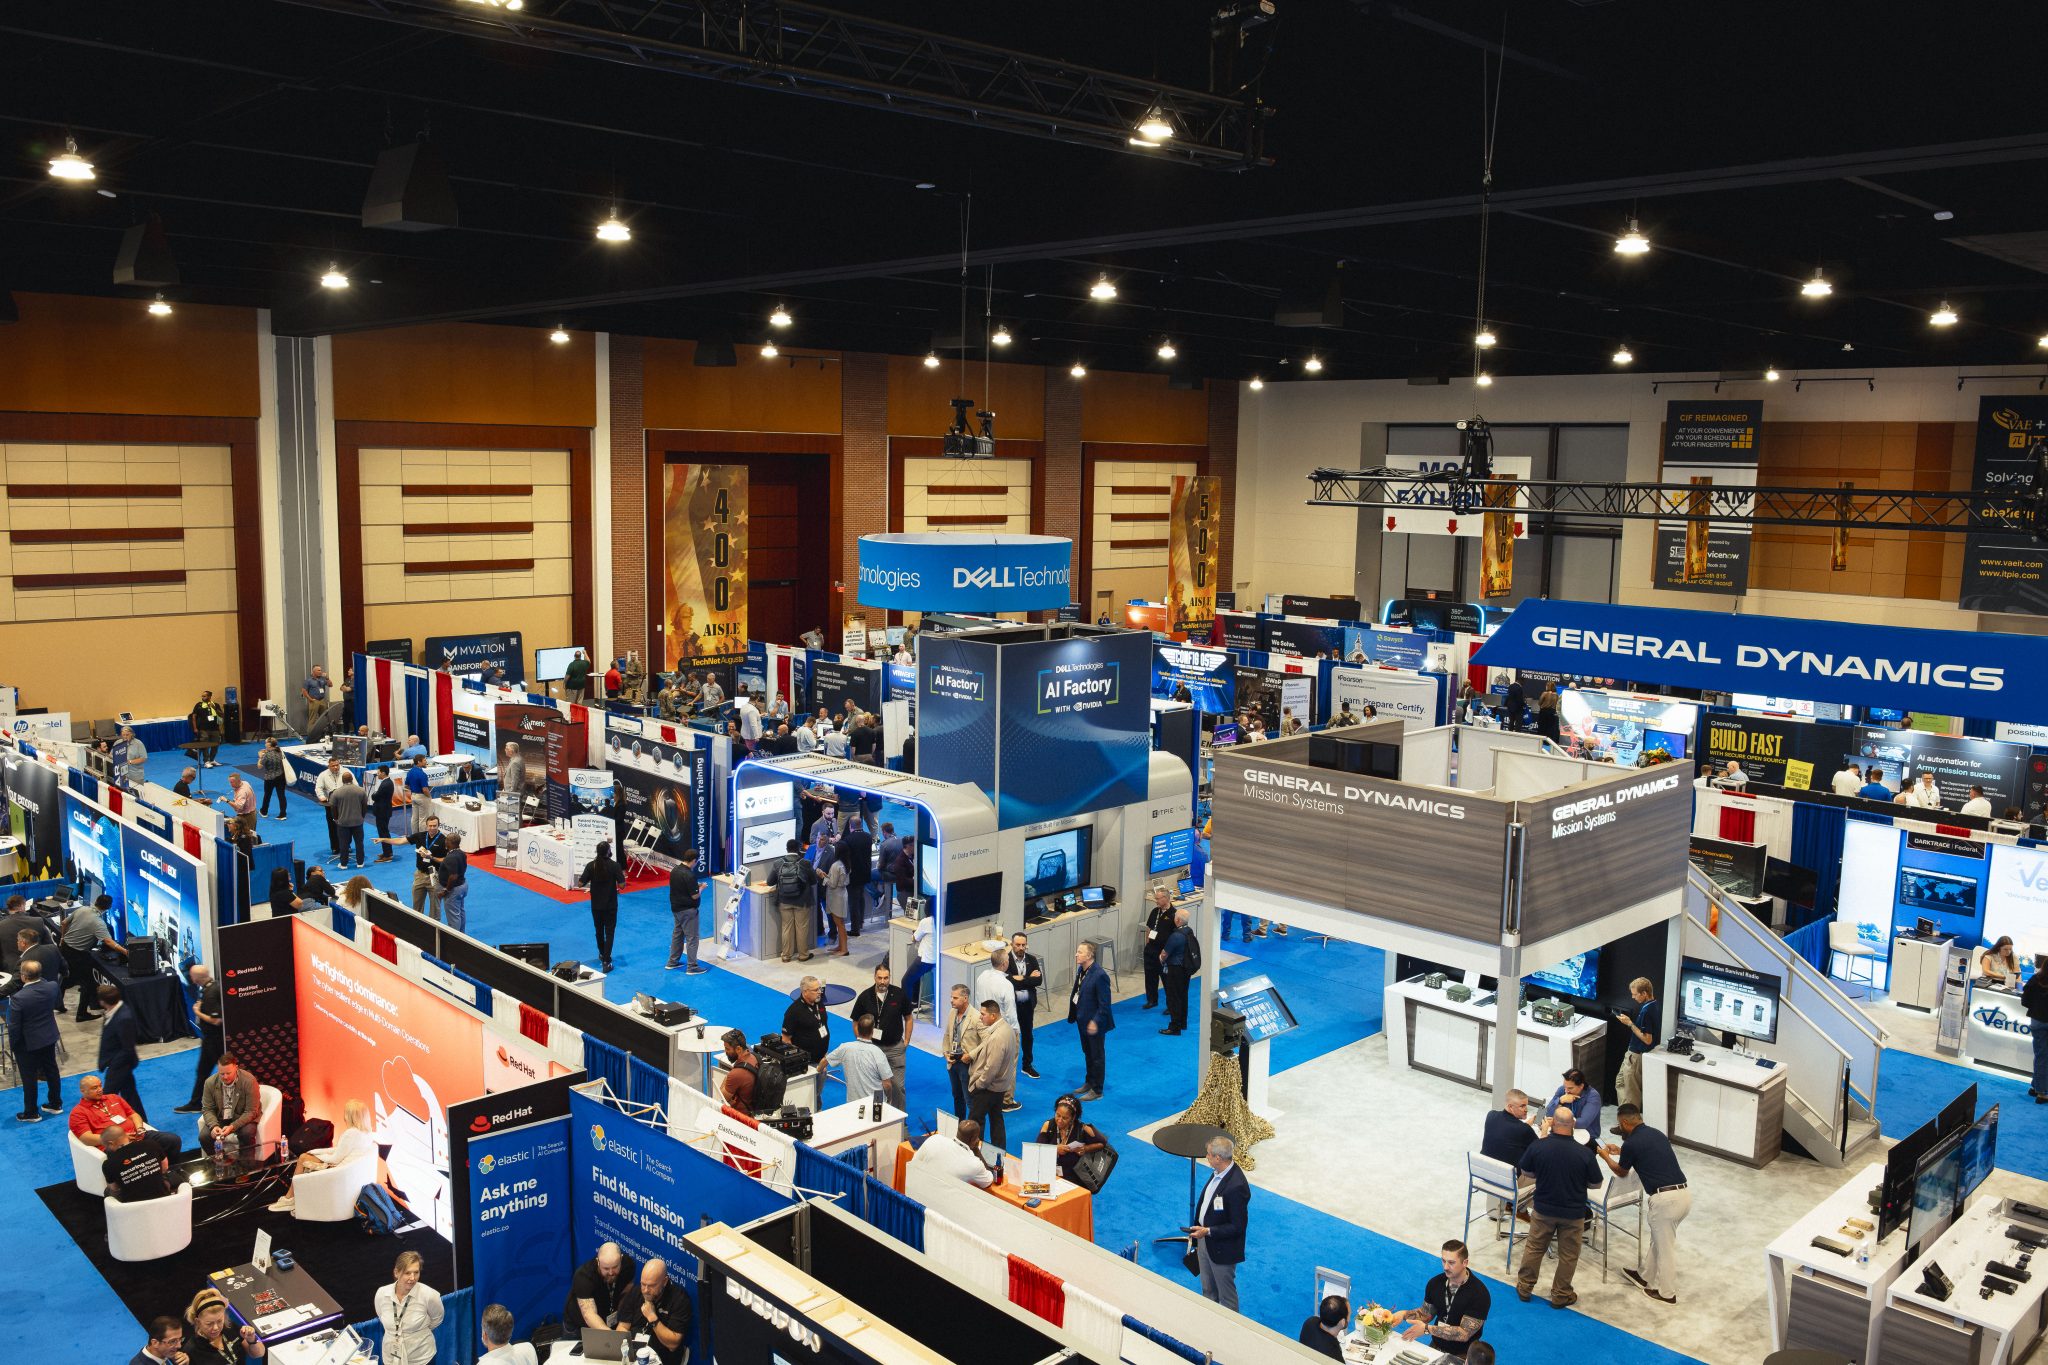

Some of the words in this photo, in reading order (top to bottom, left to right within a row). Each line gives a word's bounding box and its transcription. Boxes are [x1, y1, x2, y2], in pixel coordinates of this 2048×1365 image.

[1680, 414, 1693, 422] CIF
[1695, 414, 1748, 422] REIMAGINED
[1980, 558, 2043, 569] www.vaeit.com
[953, 566, 1015, 589] DELL
[1979, 570, 2040, 580] www.itpie.com
[1188, 596, 1212, 608] AISLE
[703, 622, 741, 637] AISLE
[459, 643, 505, 656] MVATION
[1532, 624, 1721, 664] GENERAL
[1737, 644, 2005, 691] DYNAMICS
[498, 660, 505, 668] IT
[691, 658, 721, 667] TechNet
[720, 655, 744, 665] Augusta
[1056, 665, 1071, 674] DELL
[1071, 662, 1104, 672] Technologies
[935, 674, 945, 685] AI
[946, 677, 979, 694] Factory
[1340, 674, 1363, 684] Pearson
[1045, 682, 1060, 699] AI
[1064, 677, 1112, 697] Factory
[1055, 704, 1071, 713] WITH
[1397, 702, 1426, 714] Certify.
[15, 721, 28, 733] hp
[1717, 720, 1742, 728] sonatype
[2007, 727, 2048, 738] possible.
[1710, 727, 1748, 753] BUILD
[1751, 732, 1784, 757] FAST
[1724, 751, 1746, 760] SECURE
[1747, 754, 1763, 762] OPEN
[1763, 756, 1787, 765] SOURCE
[1917, 753, 1926, 762] AI
[1926, 755, 1970, 767] automation
[1970, 759, 1982, 768] for
[696, 757, 705, 795] Training
[1916, 763, 1937, 773] Army
[1938, 765, 1968, 776] mission
[1969, 771, 2001, 780] success
[1243, 769, 1338, 798] GENERAL
[1344, 786, 1466, 819] DYNAMICS
[1243, 784, 1295, 806] Mission
[1299, 793, 1345, 816] Systems
[1552, 793, 1613, 822] GENERAL
[1615, 775, 1679, 804] DYNAMICS
[696, 796, 705, 847] Workforce
[1552, 818, 1583, 839] Mission
[1584, 809, 1617, 835] Systems
[957, 852, 968, 860] Data
[969, 847, 990, 858] Platform
[1914, 838, 1951, 849] DARKTRACE
[1954, 844, 1979, 853] Federal
[697, 848, 705, 873] Cyber
[237, 967, 247, 975] Red
[247, 966, 257, 974] Hat
[1702, 962, 1714, 970] Next
[1724, 967, 1745, 977] Survival
[1745, 971, 1760, 980] Radio
[238, 985, 249, 993] Red
[238, 989, 263, 998] Enterprise
[264, 986, 277, 994] Linux
[311, 953, 353, 993] Warfighting
[354, 978, 399, 1017] dominance:
[312, 973, 322, 986] The
[402, 1028, 431, 1055] Operations
[509, 1055, 523, 1072] Red
[523, 1063, 536, 1079] Hat
[492, 1110, 513, 1125] Red
[514, 1105, 533, 1119] Hat
[717, 1123, 749, 1143] Elasticsearch
[544, 1146, 567, 1156] Company
[547, 1140, 564, 1149] Search
[608, 1138, 638, 1164] elastic
[497, 1150, 530, 1166] elastic
[645, 1154, 655, 1165] The
[655, 1158, 673, 1174] Search
[119, 1162, 146, 1177] Securing
[145, 1157, 158, 1168] open
[139, 1161, 160, 1175] software
[645, 1163, 652, 1172] AI
[652, 1167, 675, 1186] Company
[130, 1175, 142, 1183] over
[480, 1182, 510, 1203] Ask
[513, 1178, 538, 1194] me
[592, 1165, 617, 1193] Find
[618, 1180, 637, 1205] the
[639, 1192, 685, 1230] mission
[480, 1192, 548, 1221] anything
[593, 1189, 643, 1226] answers
[641, 1214, 665, 1241] that
[481, 1225, 510, 1238] elastic.co
[594, 1215, 620, 1238] Transform
[620, 1231, 641, 1250] massive
[641, 1243, 665, 1263] amounts
[665, 1259, 673, 1268] of
[672, 1262, 686, 1277] data
[594, 1228, 615, 1245] insights
[679, 1278, 686, 1288] AI
